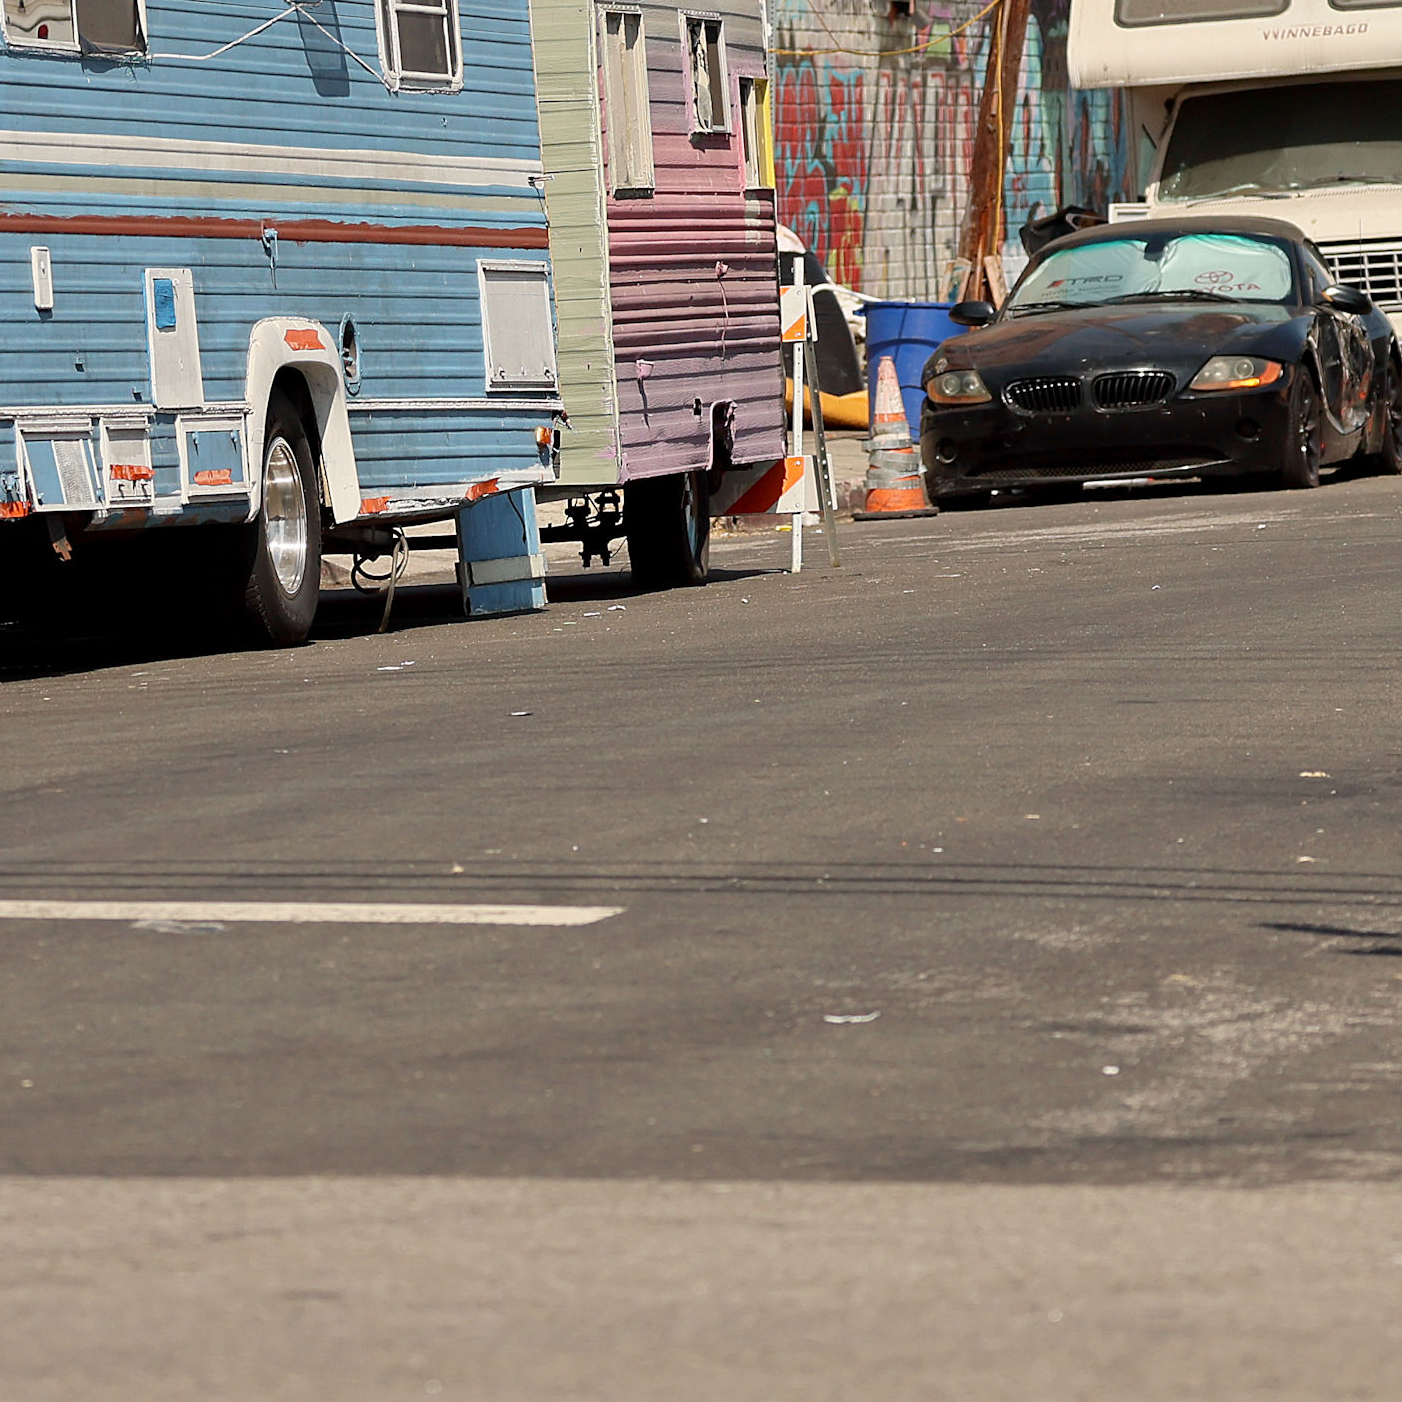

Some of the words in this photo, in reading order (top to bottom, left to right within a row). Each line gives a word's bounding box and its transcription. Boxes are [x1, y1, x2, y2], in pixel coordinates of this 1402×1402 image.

[1262, 23, 1368, 40] WINNEBAGO
[1066, 275, 1123, 286] TRD
[1198, 282, 1262, 293] YOTA
